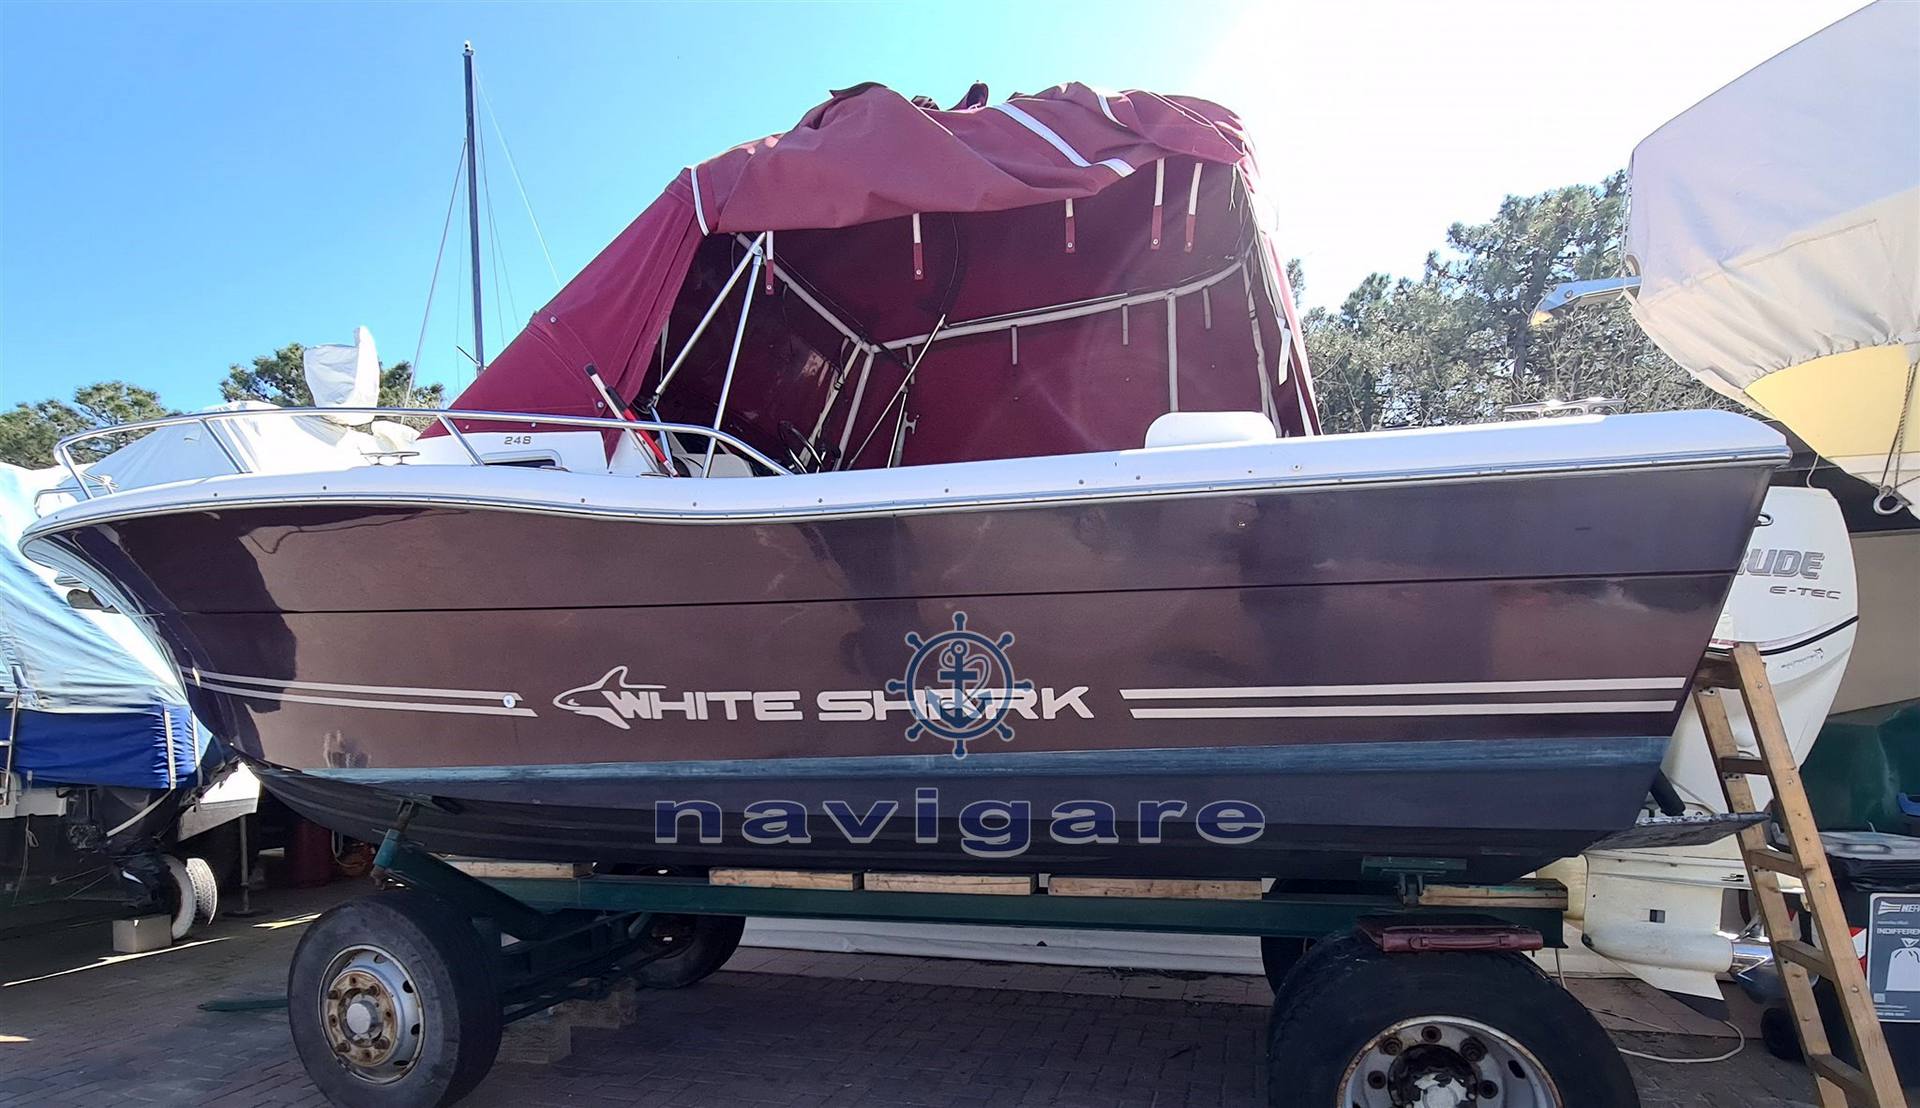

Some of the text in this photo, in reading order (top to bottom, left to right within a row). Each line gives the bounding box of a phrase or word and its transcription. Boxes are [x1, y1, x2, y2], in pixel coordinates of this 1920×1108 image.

[1769, 586, 1841, 600] E-TEC
[601, 686, 1095, 721] WHITE SHARK
